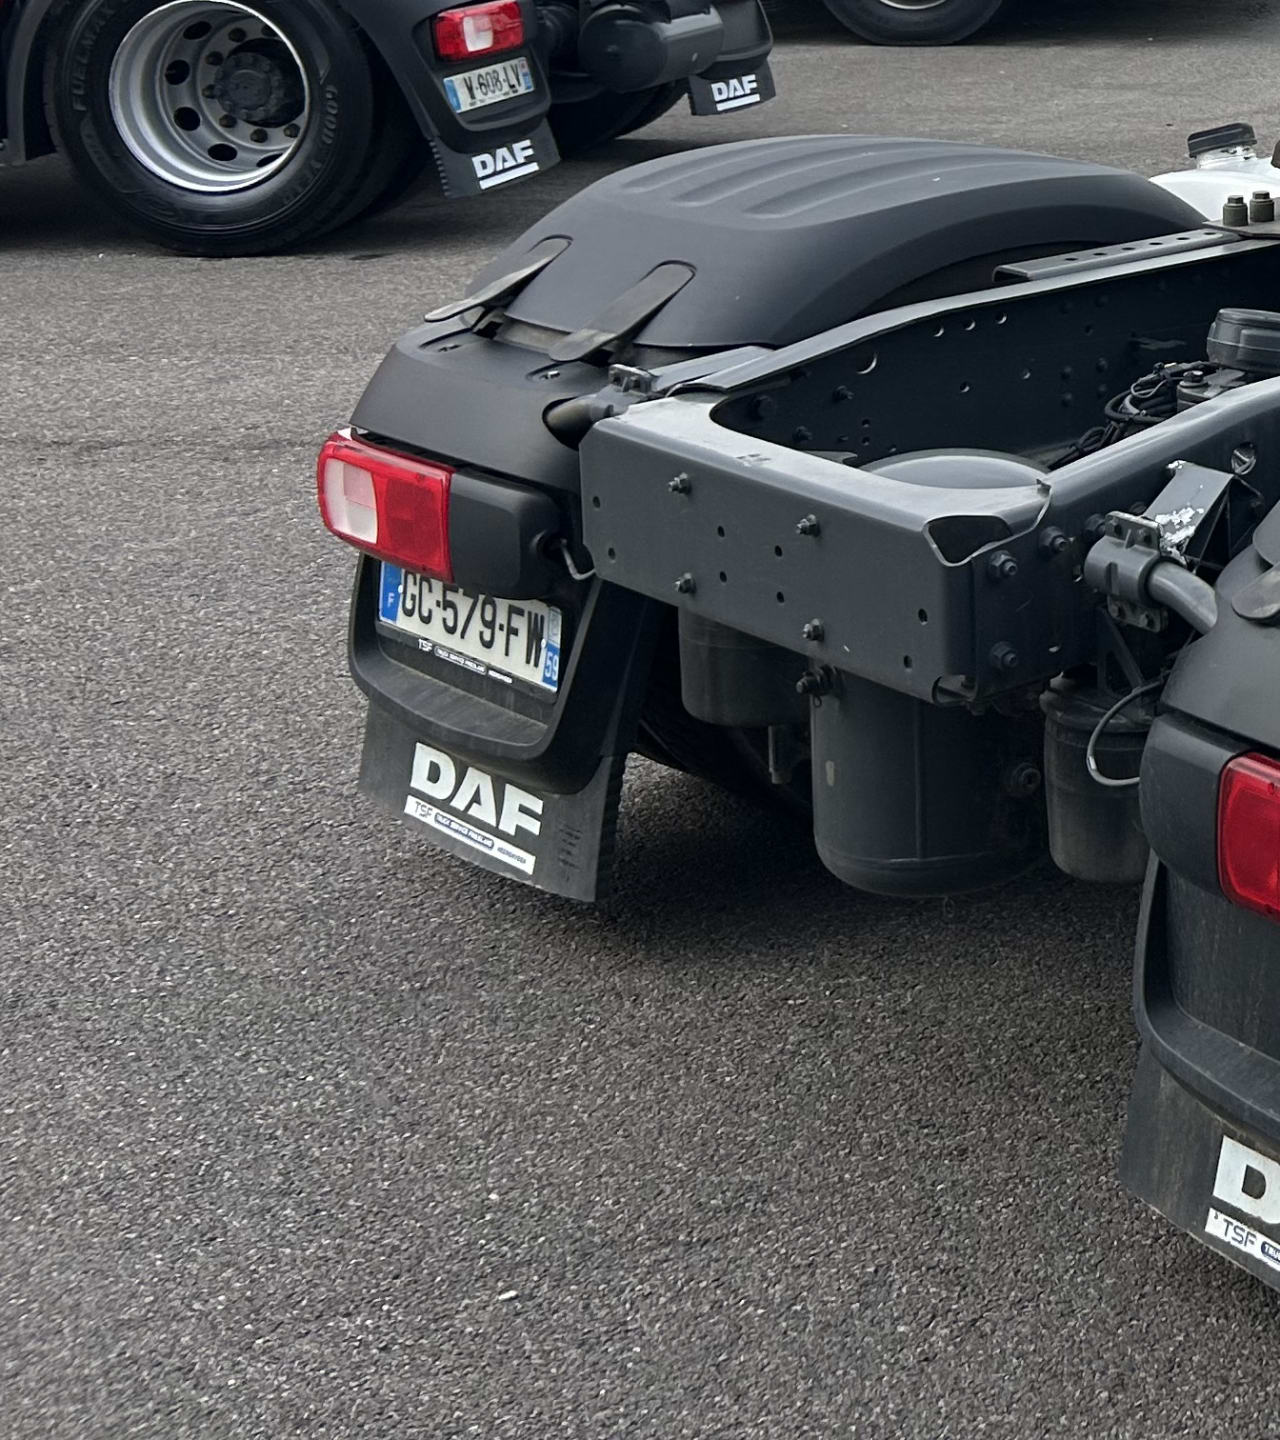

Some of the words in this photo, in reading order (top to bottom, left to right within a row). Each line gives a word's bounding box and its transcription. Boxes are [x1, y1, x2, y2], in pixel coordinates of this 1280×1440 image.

[711, 74, 758, 102] DAF
[471, 139, 535, 178] DAF
[402, 570, 545, 668] GC-579-FW
[545, 652, 559, 682] 59
[410, 742, 544, 836] DAF
[415, 801, 433, 818] TSF
[1222, 1218, 1257, 1247] TSF
